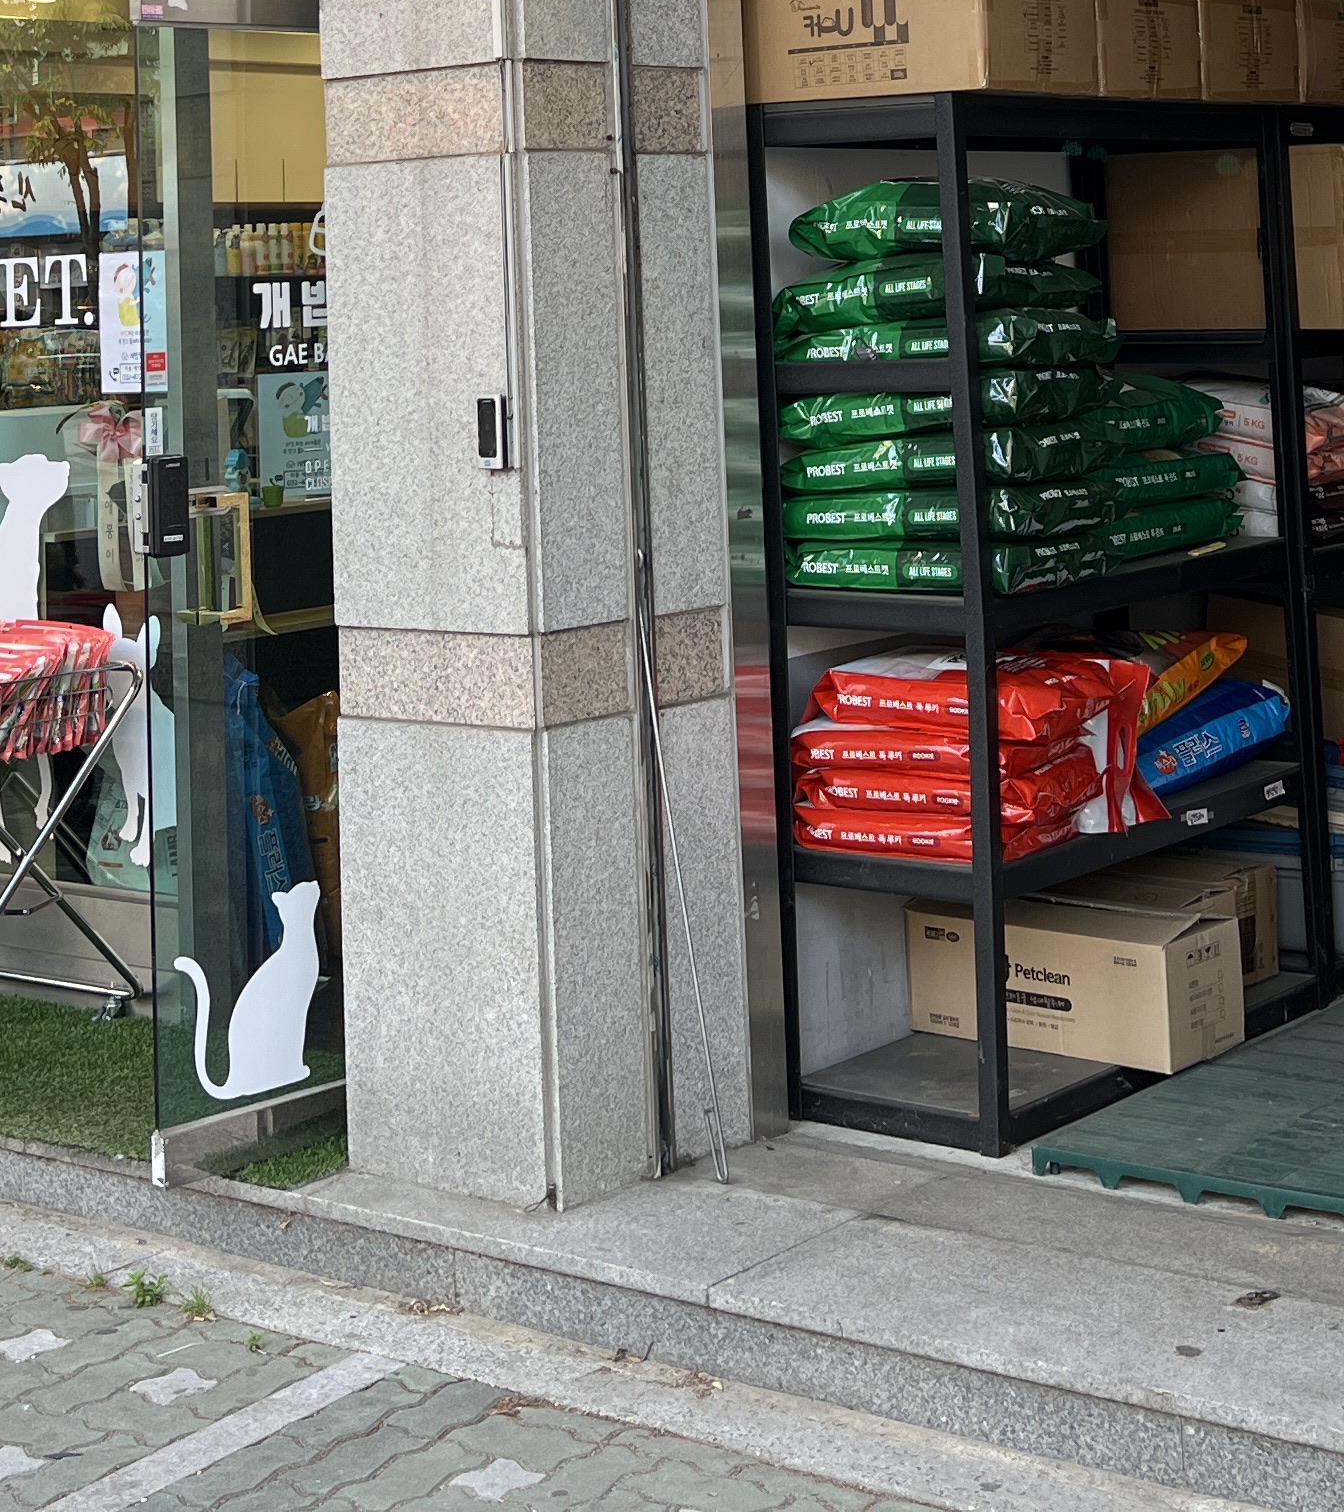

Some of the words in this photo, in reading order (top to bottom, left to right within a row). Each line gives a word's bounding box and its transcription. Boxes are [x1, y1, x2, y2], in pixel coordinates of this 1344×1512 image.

[906, 219, 916, 230] ALL
[885, 283, 894, 294] ALL
[895, 282, 905, 293] LIFE
[252, 280, 327, 329] 개밥
[910, 339, 920, 351] ALL
[921, 338, 933, 350] LIFE
[269, 343, 308, 366] GAE
[913, 401, 923, 412] ALL
[924, 400, 935, 411] LIFE
[810, 410, 843, 427] ROBEST
[1250, 418, 1266, 430] KG
[305, 458, 330, 474] OPE
[913, 457, 923, 468] ALL
[924, 456, 935, 468] LIFE
[936, 455, 956, 467] STAGES
[1244, 454, 1258, 466] KG
[807, 464, 846, 478] PROBEST
[806, 512, 846, 525] PROBEST
[913, 511, 924, 523] ALL
[925, 510, 936, 522] LIFE
[936, 509, 957, 522] STAGES
[908, 566, 919, 577] ALL
[919, 566, 931, 577] LIFE
[931, 566, 952, 578] STAGES
[1014, 963, 1071, 987] Petclean
